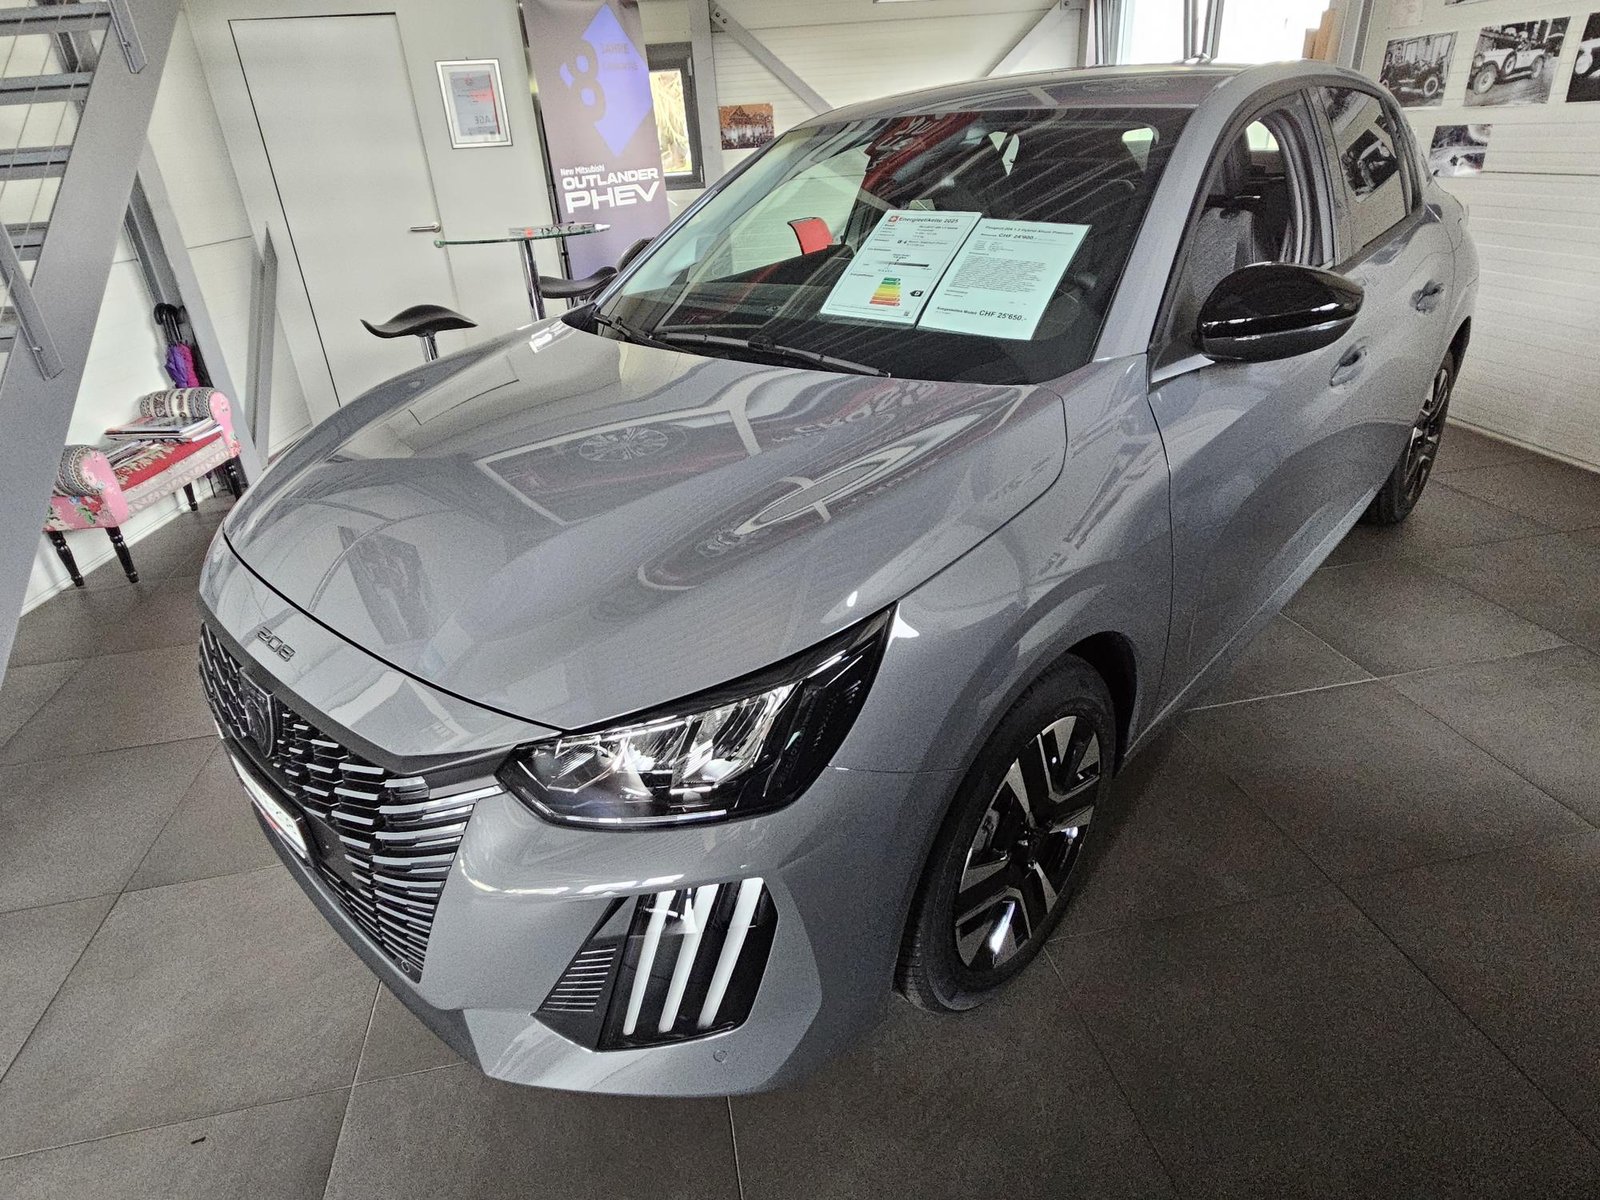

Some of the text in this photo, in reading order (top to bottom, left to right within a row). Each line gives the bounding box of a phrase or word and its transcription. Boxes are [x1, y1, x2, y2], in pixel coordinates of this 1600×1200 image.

[560, 164, 605, 176] New Mitsubishi
[562, 167, 659, 190] OUTLANDER
[564, 181, 660, 214] PHEV
[257, 626, 296, 662] 208
